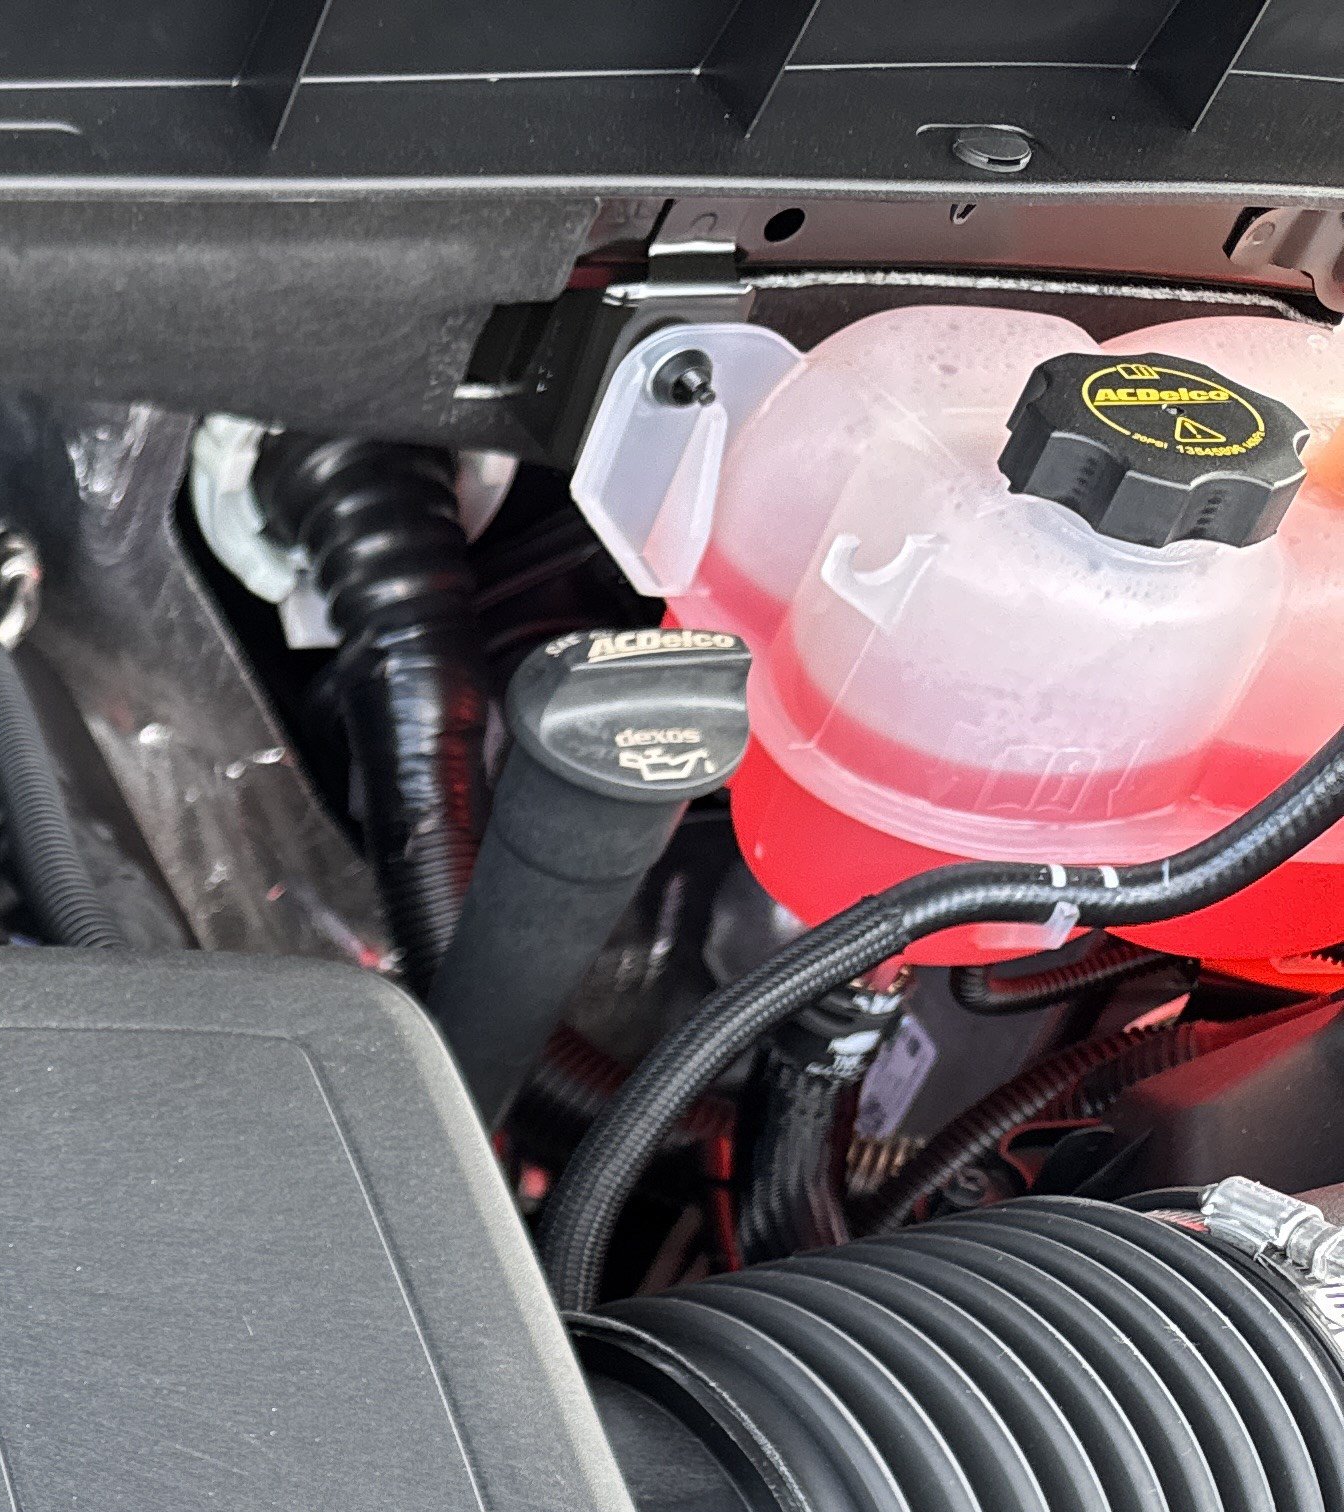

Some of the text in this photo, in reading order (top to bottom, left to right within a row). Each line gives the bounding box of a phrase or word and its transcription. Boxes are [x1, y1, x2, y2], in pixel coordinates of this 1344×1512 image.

[1094, 387, 1230, 401] ACDelco
[587, 630, 736, 657] ACDelco
[614, 727, 702, 748] dexos
